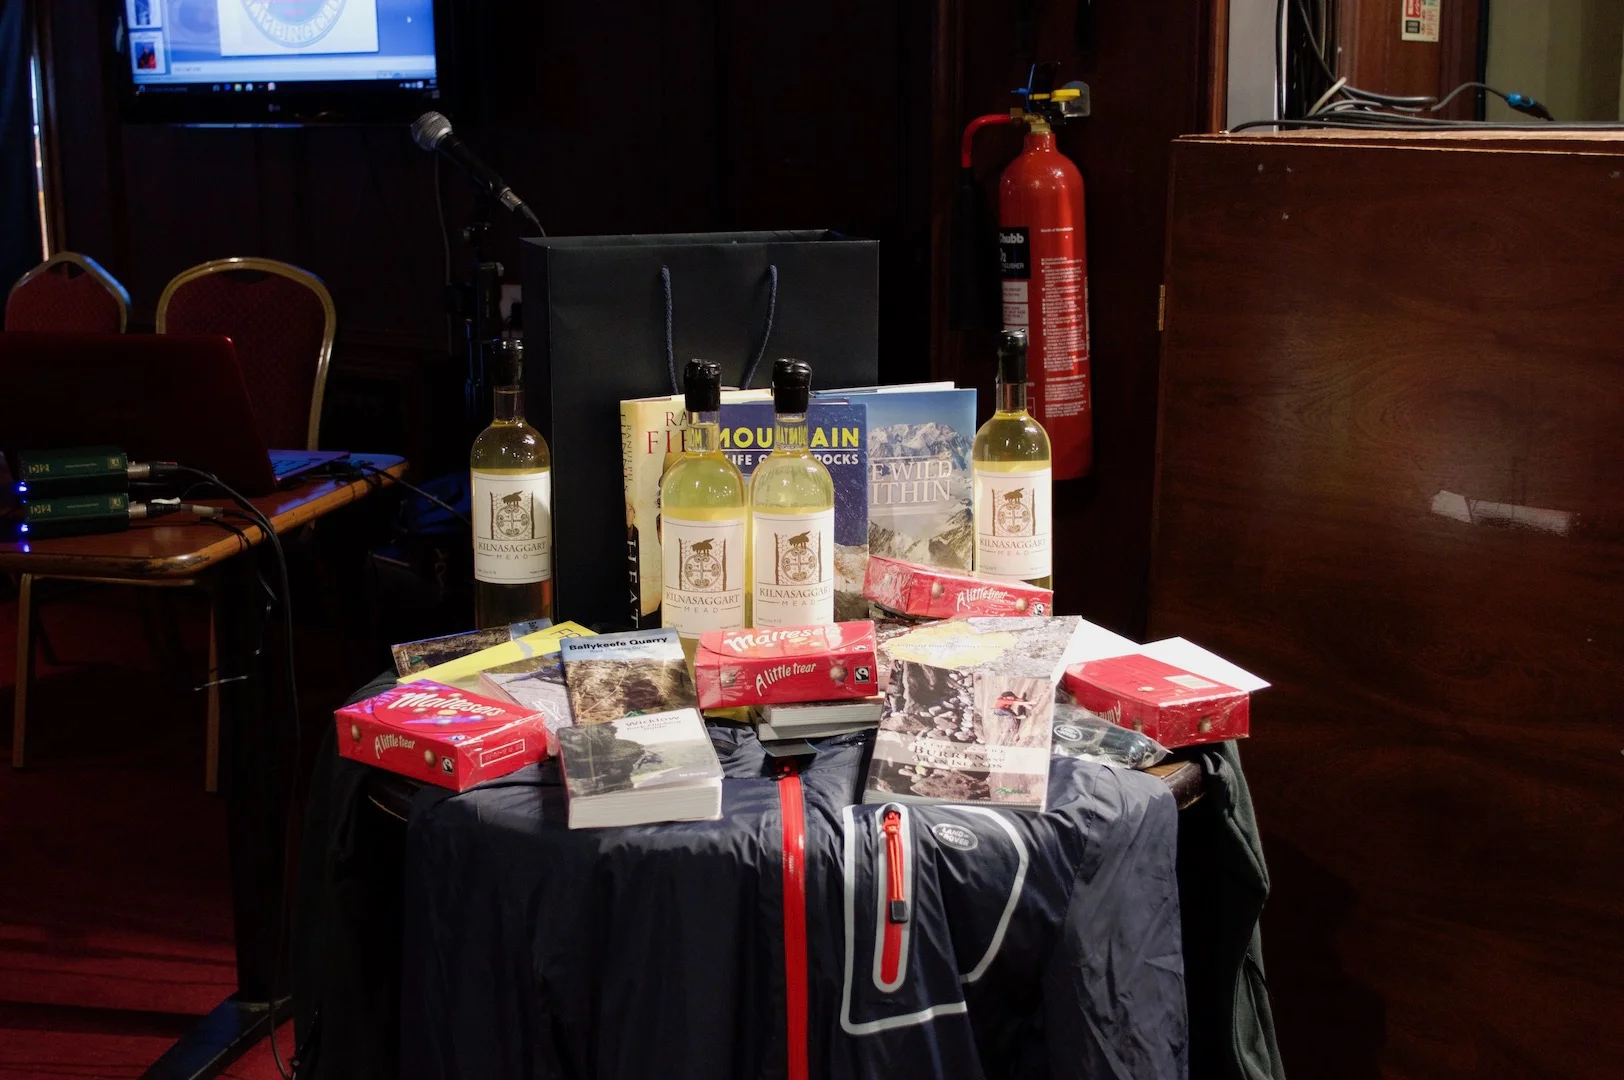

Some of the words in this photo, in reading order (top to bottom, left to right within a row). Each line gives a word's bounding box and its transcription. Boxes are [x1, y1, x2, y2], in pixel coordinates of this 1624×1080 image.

[720, 427, 859, 448] MOUAIN
[889, 460, 953, 481] WILD
[871, 480, 952, 505] ITHIN
[478, 541, 547, 553] KILNASAGGART
[627, 540, 640, 629] HEAT
[759, 585, 832, 599] KILNASAGGART
[666, 591, 741, 605] KILNASAGGART
[683, 606, 719, 614] MEAD
[569, 641, 627, 651] Ballykeefe
[629, 637, 668, 646] Quarry
[755, 674, 768, 697] A
[763, 664, 792, 686] little
[387, 692, 506, 717] Maltesers
[624, 716, 680, 727] Wicklow
[374, 736, 385, 760] A
[381, 733, 399, 750] little
[914, 745, 984, 761] BURREN
[941, 826, 964, 838] LAND
[942, 832, 970, 847] ROVER
